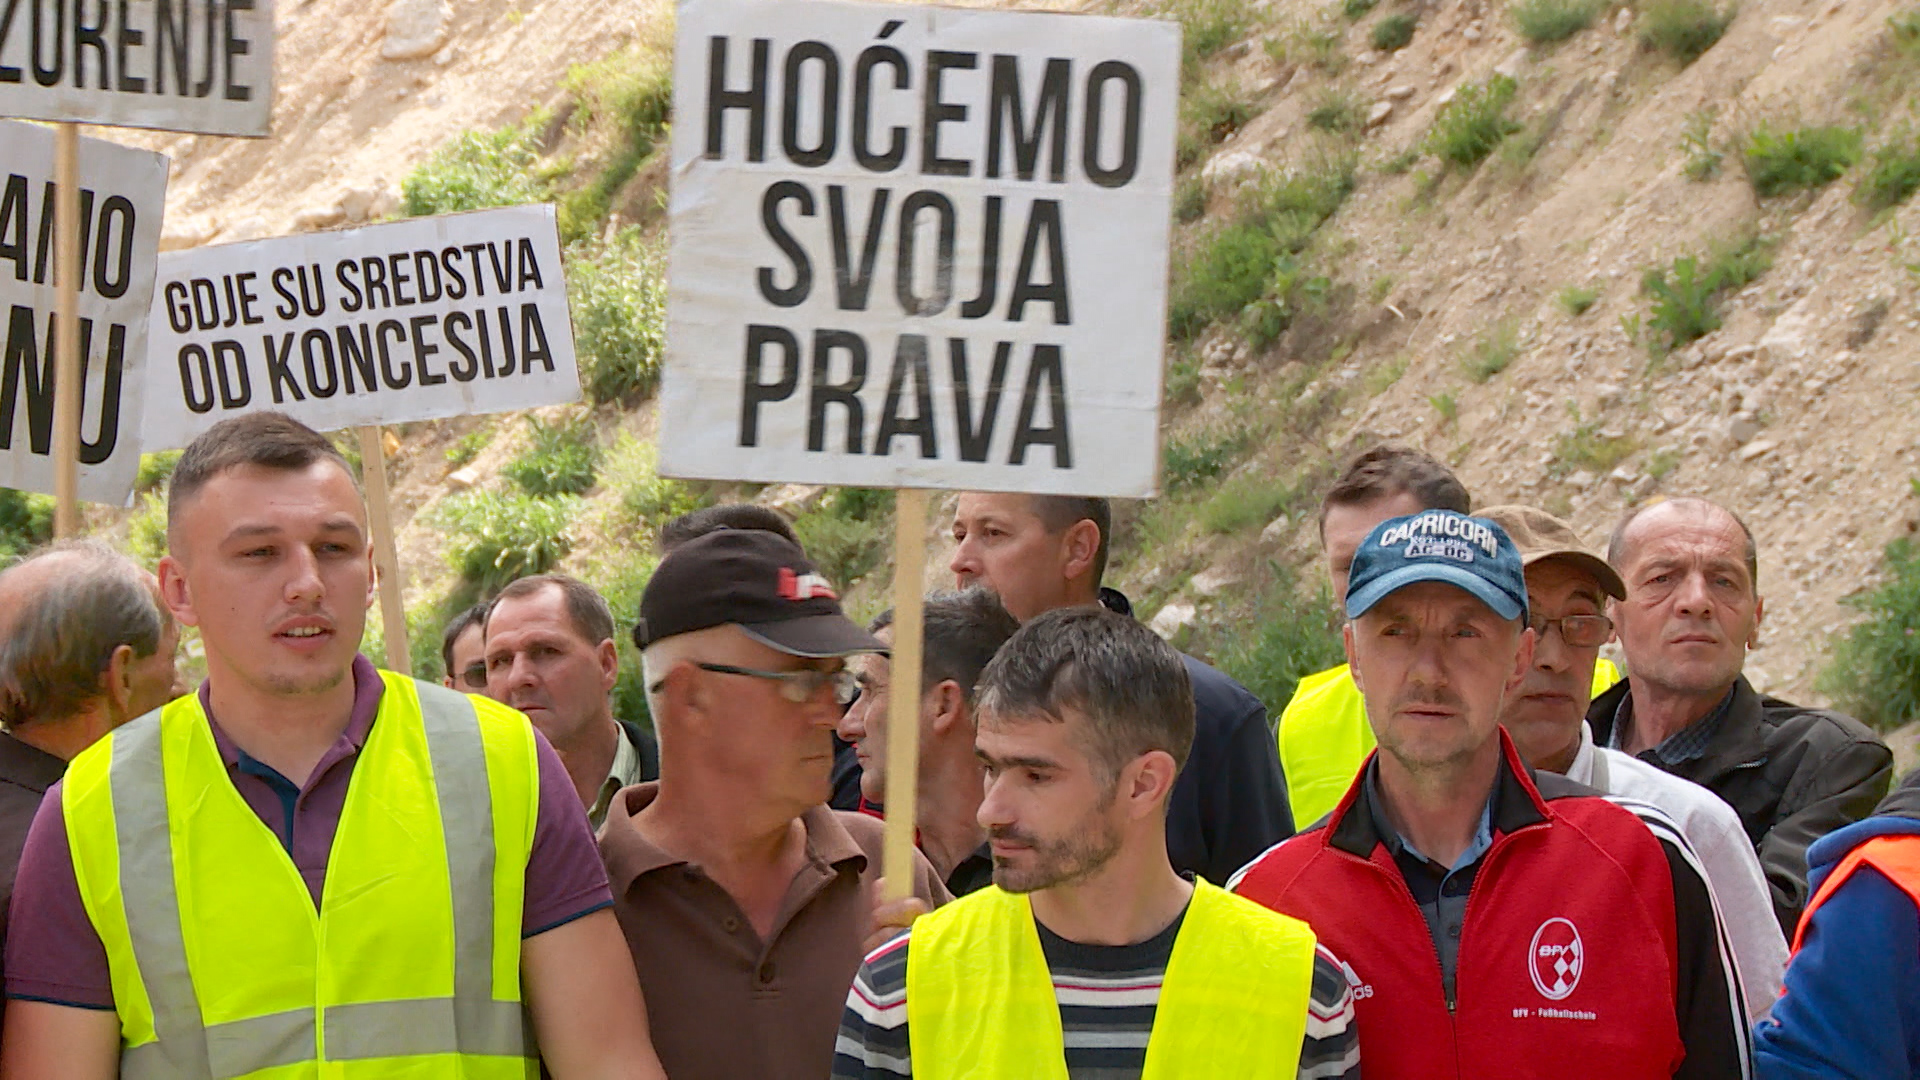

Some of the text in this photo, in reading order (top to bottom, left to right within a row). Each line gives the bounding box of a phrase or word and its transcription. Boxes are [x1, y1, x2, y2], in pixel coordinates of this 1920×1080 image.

[703, 20, 1142, 189] HOĆEMO
[164, 237, 544, 333] GDJE SU SREDSTVA
[756, 180, 1073, 326] SVOJA
[177, 303, 555, 414] OD KONCESIJA
[737, 324, 1074, 469] PRAVA
[1380, 513, 1498, 559] CAPRICORN
